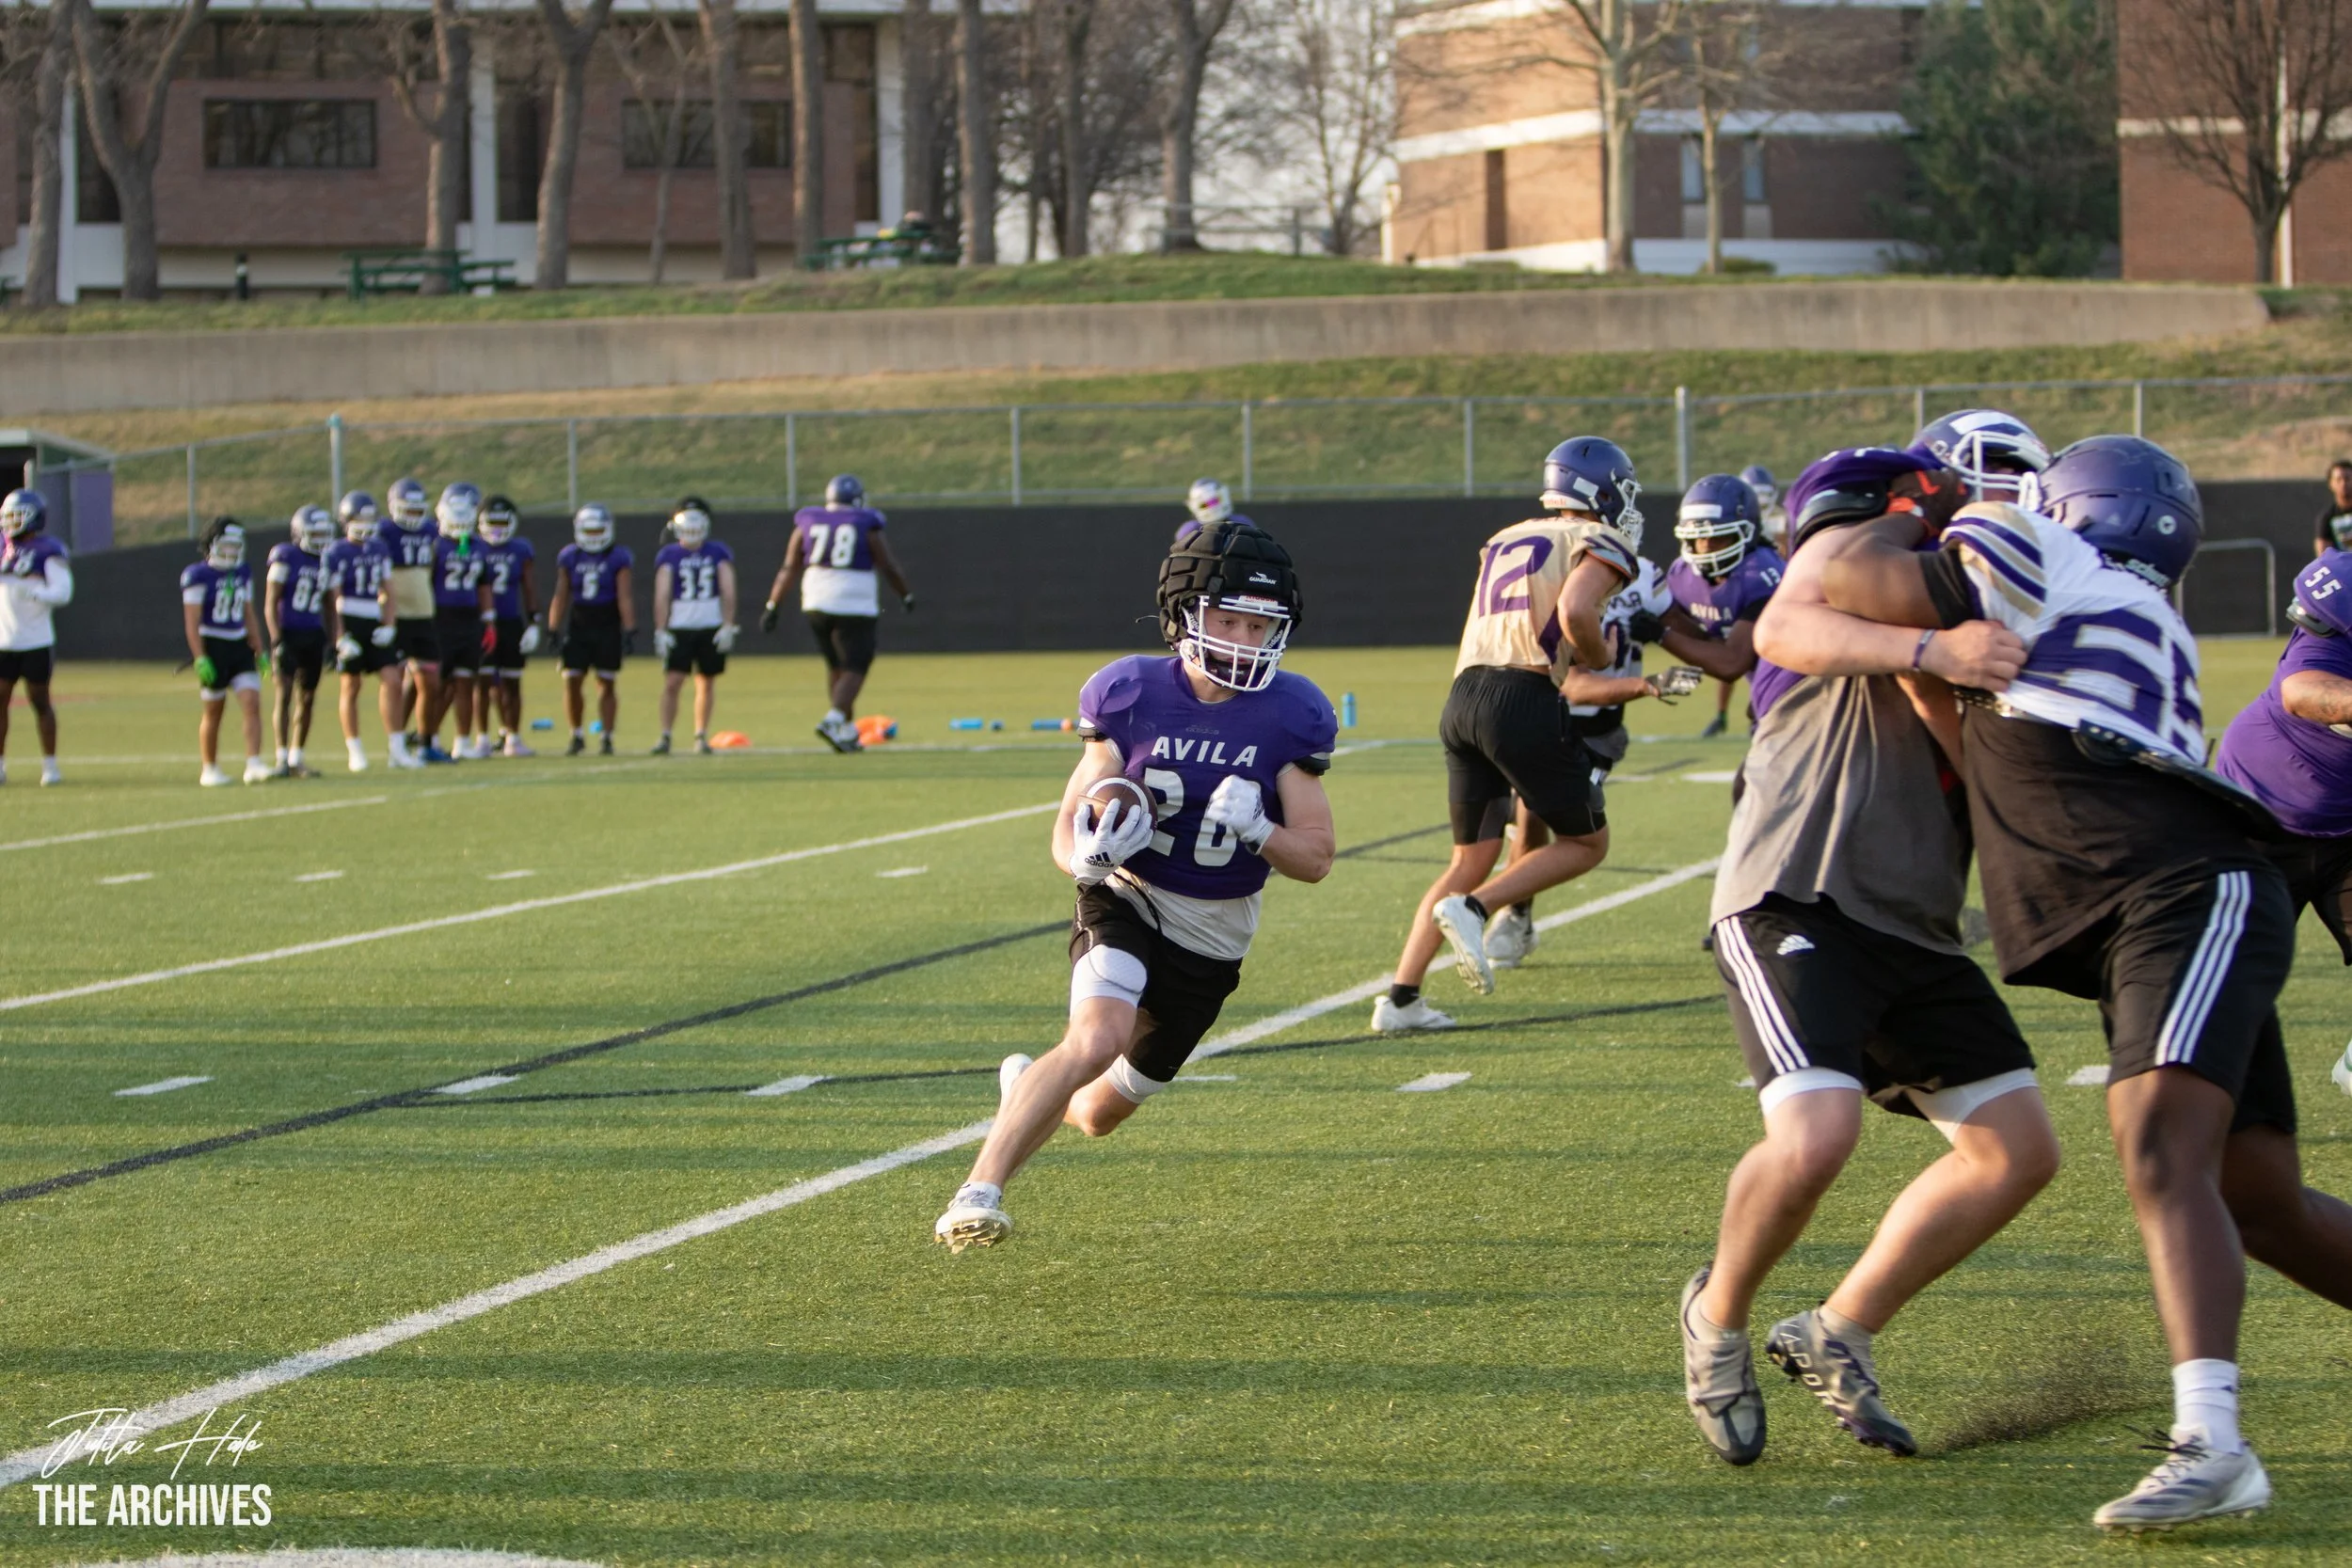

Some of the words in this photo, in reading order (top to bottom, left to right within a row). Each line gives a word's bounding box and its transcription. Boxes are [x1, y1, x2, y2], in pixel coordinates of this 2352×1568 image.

[809, 524, 857, 566] 78
[678, 566, 713, 600] 35
[1479, 535, 1553, 618] 12
[2304, 566, 2342, 600] 55
[1151, 736, 1258, 768] AVILA
[1084, 857, 1115, 868] adidas
